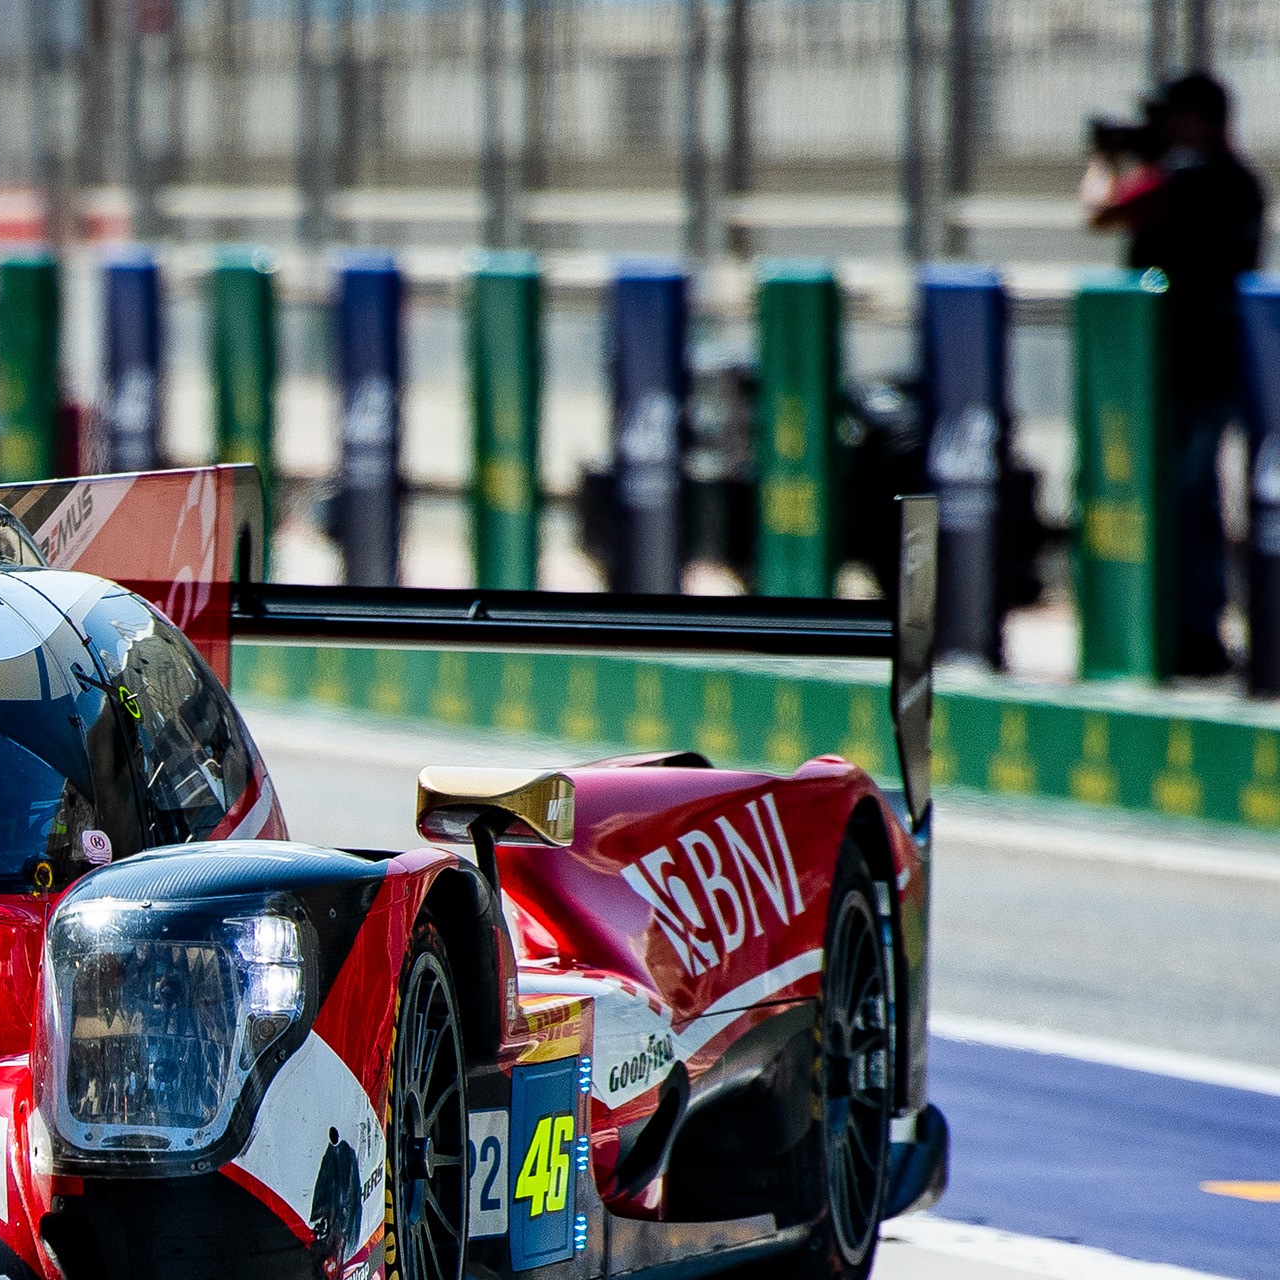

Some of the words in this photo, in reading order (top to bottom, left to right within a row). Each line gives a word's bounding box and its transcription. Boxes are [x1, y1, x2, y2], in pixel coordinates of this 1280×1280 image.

[677, 792, 807, 955] BNI
[609, 1033, 675, 1093] GOODYEAR
[514, 1115, 575, 1217] 46
